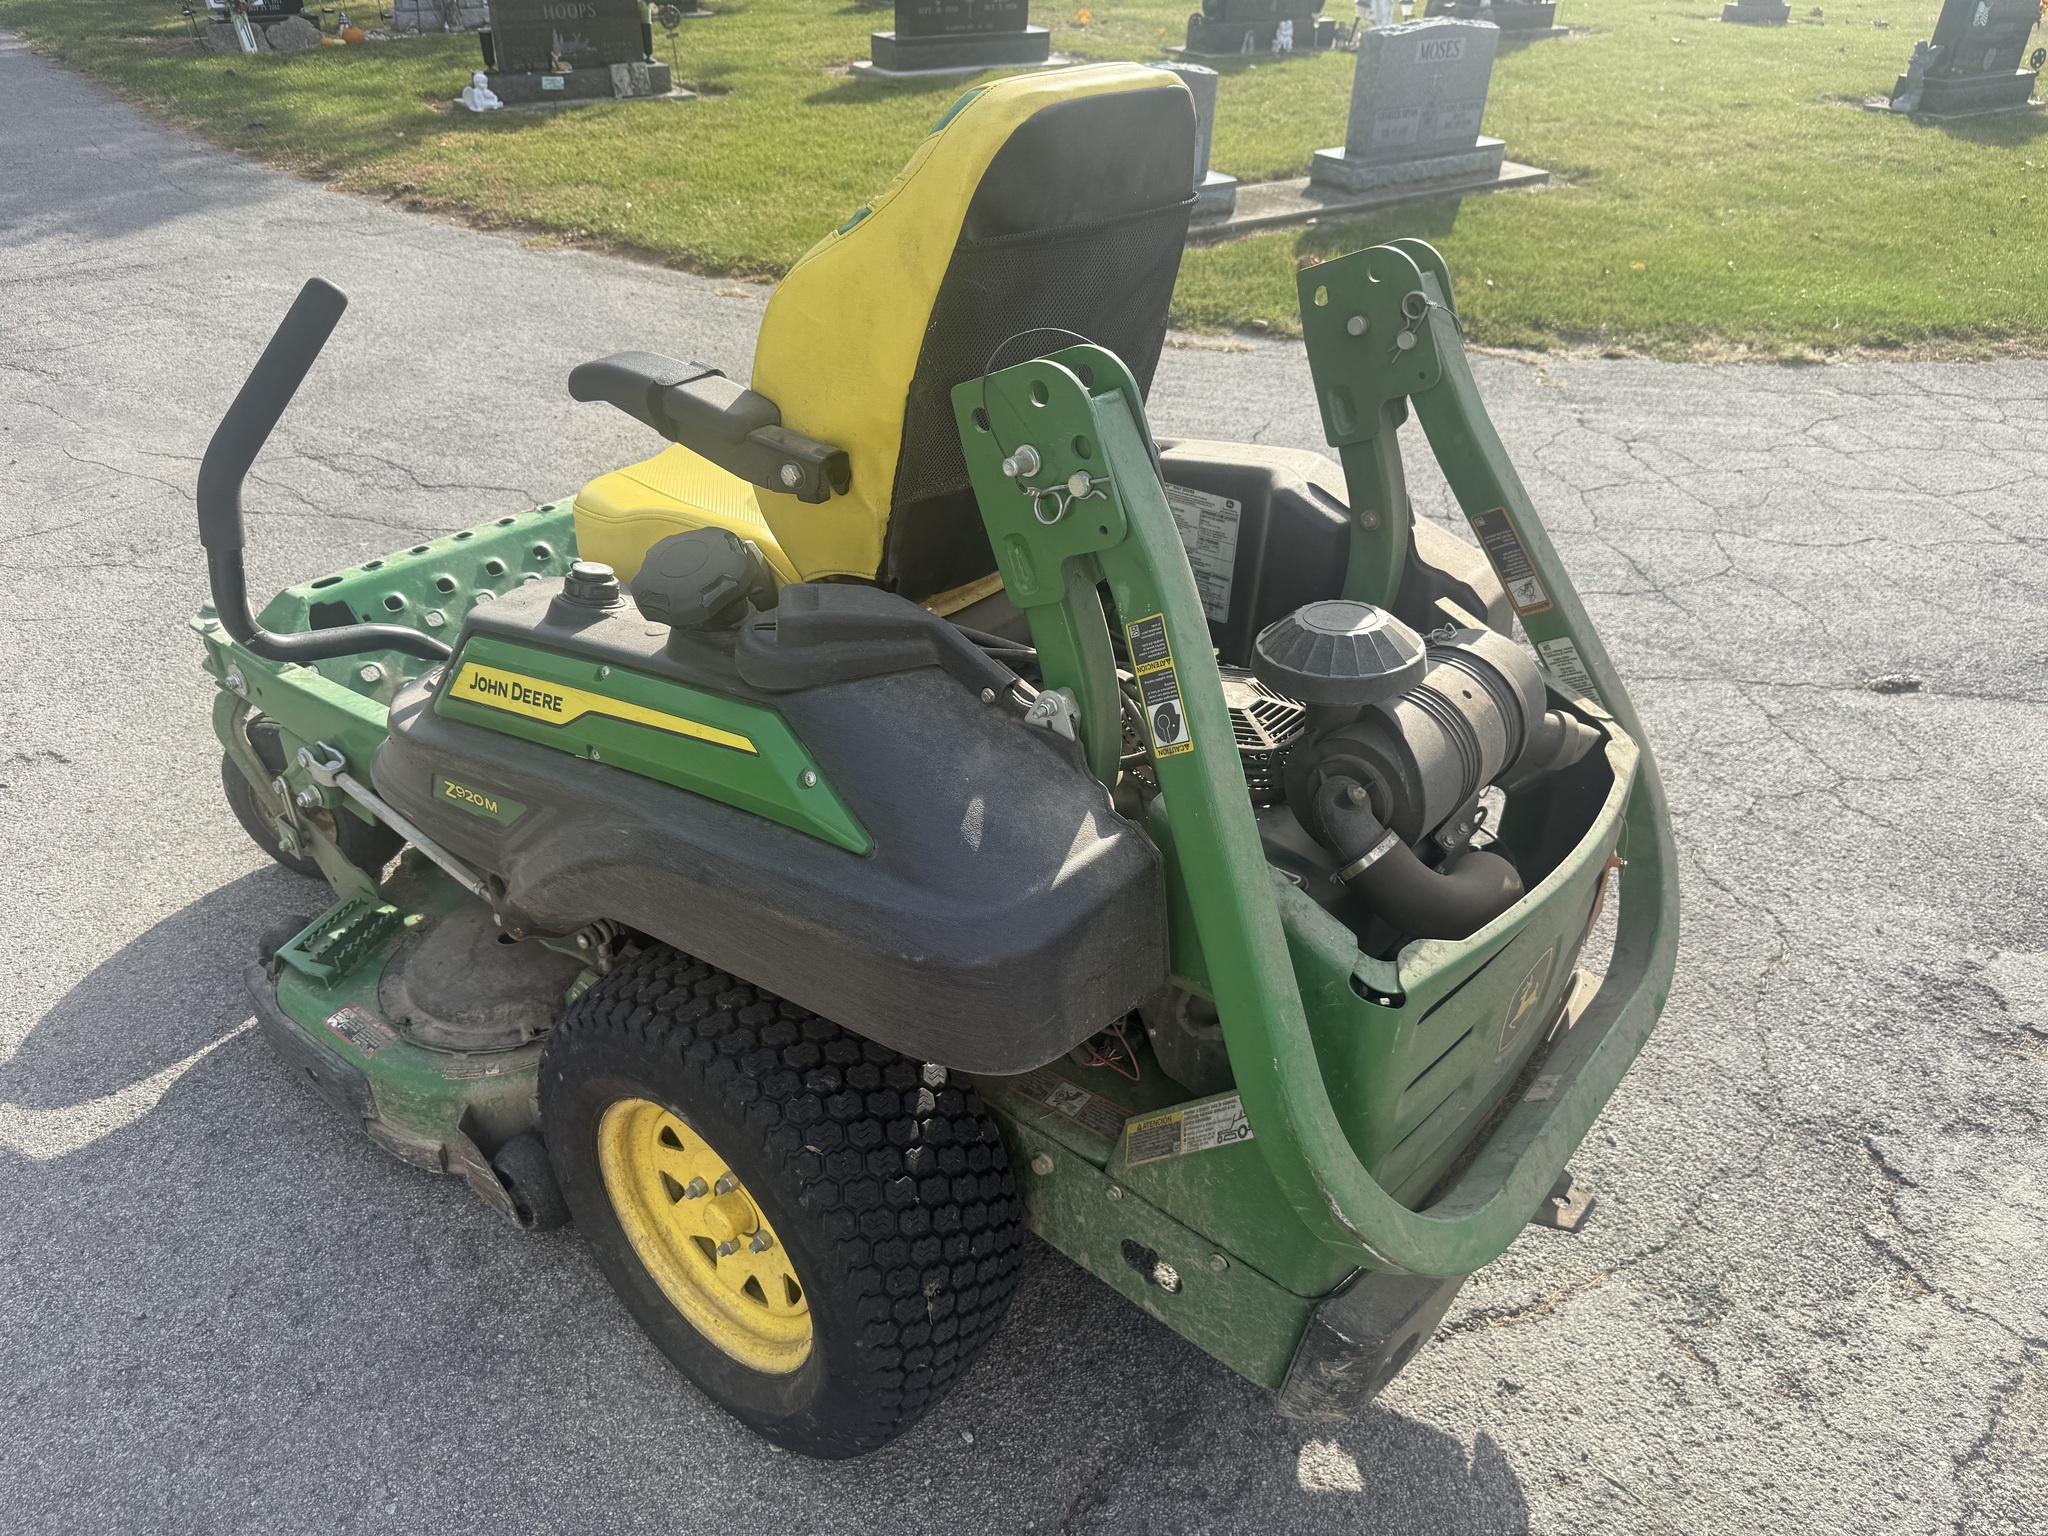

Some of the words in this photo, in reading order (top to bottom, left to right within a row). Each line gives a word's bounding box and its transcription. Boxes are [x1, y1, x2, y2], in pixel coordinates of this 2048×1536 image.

[543, 3, 596, 20] HOOPS
[1420, 40, 1461, 60] MOSES
[470, 672, 508, 698] JOHN
[511, 681, 563, 713] DEERE
[1158, 745, 1184, 756] CAUTION
[443, 781, 498, 813] Z920M
[1143, 1116, 1172, 1129] ATENCIÓN
